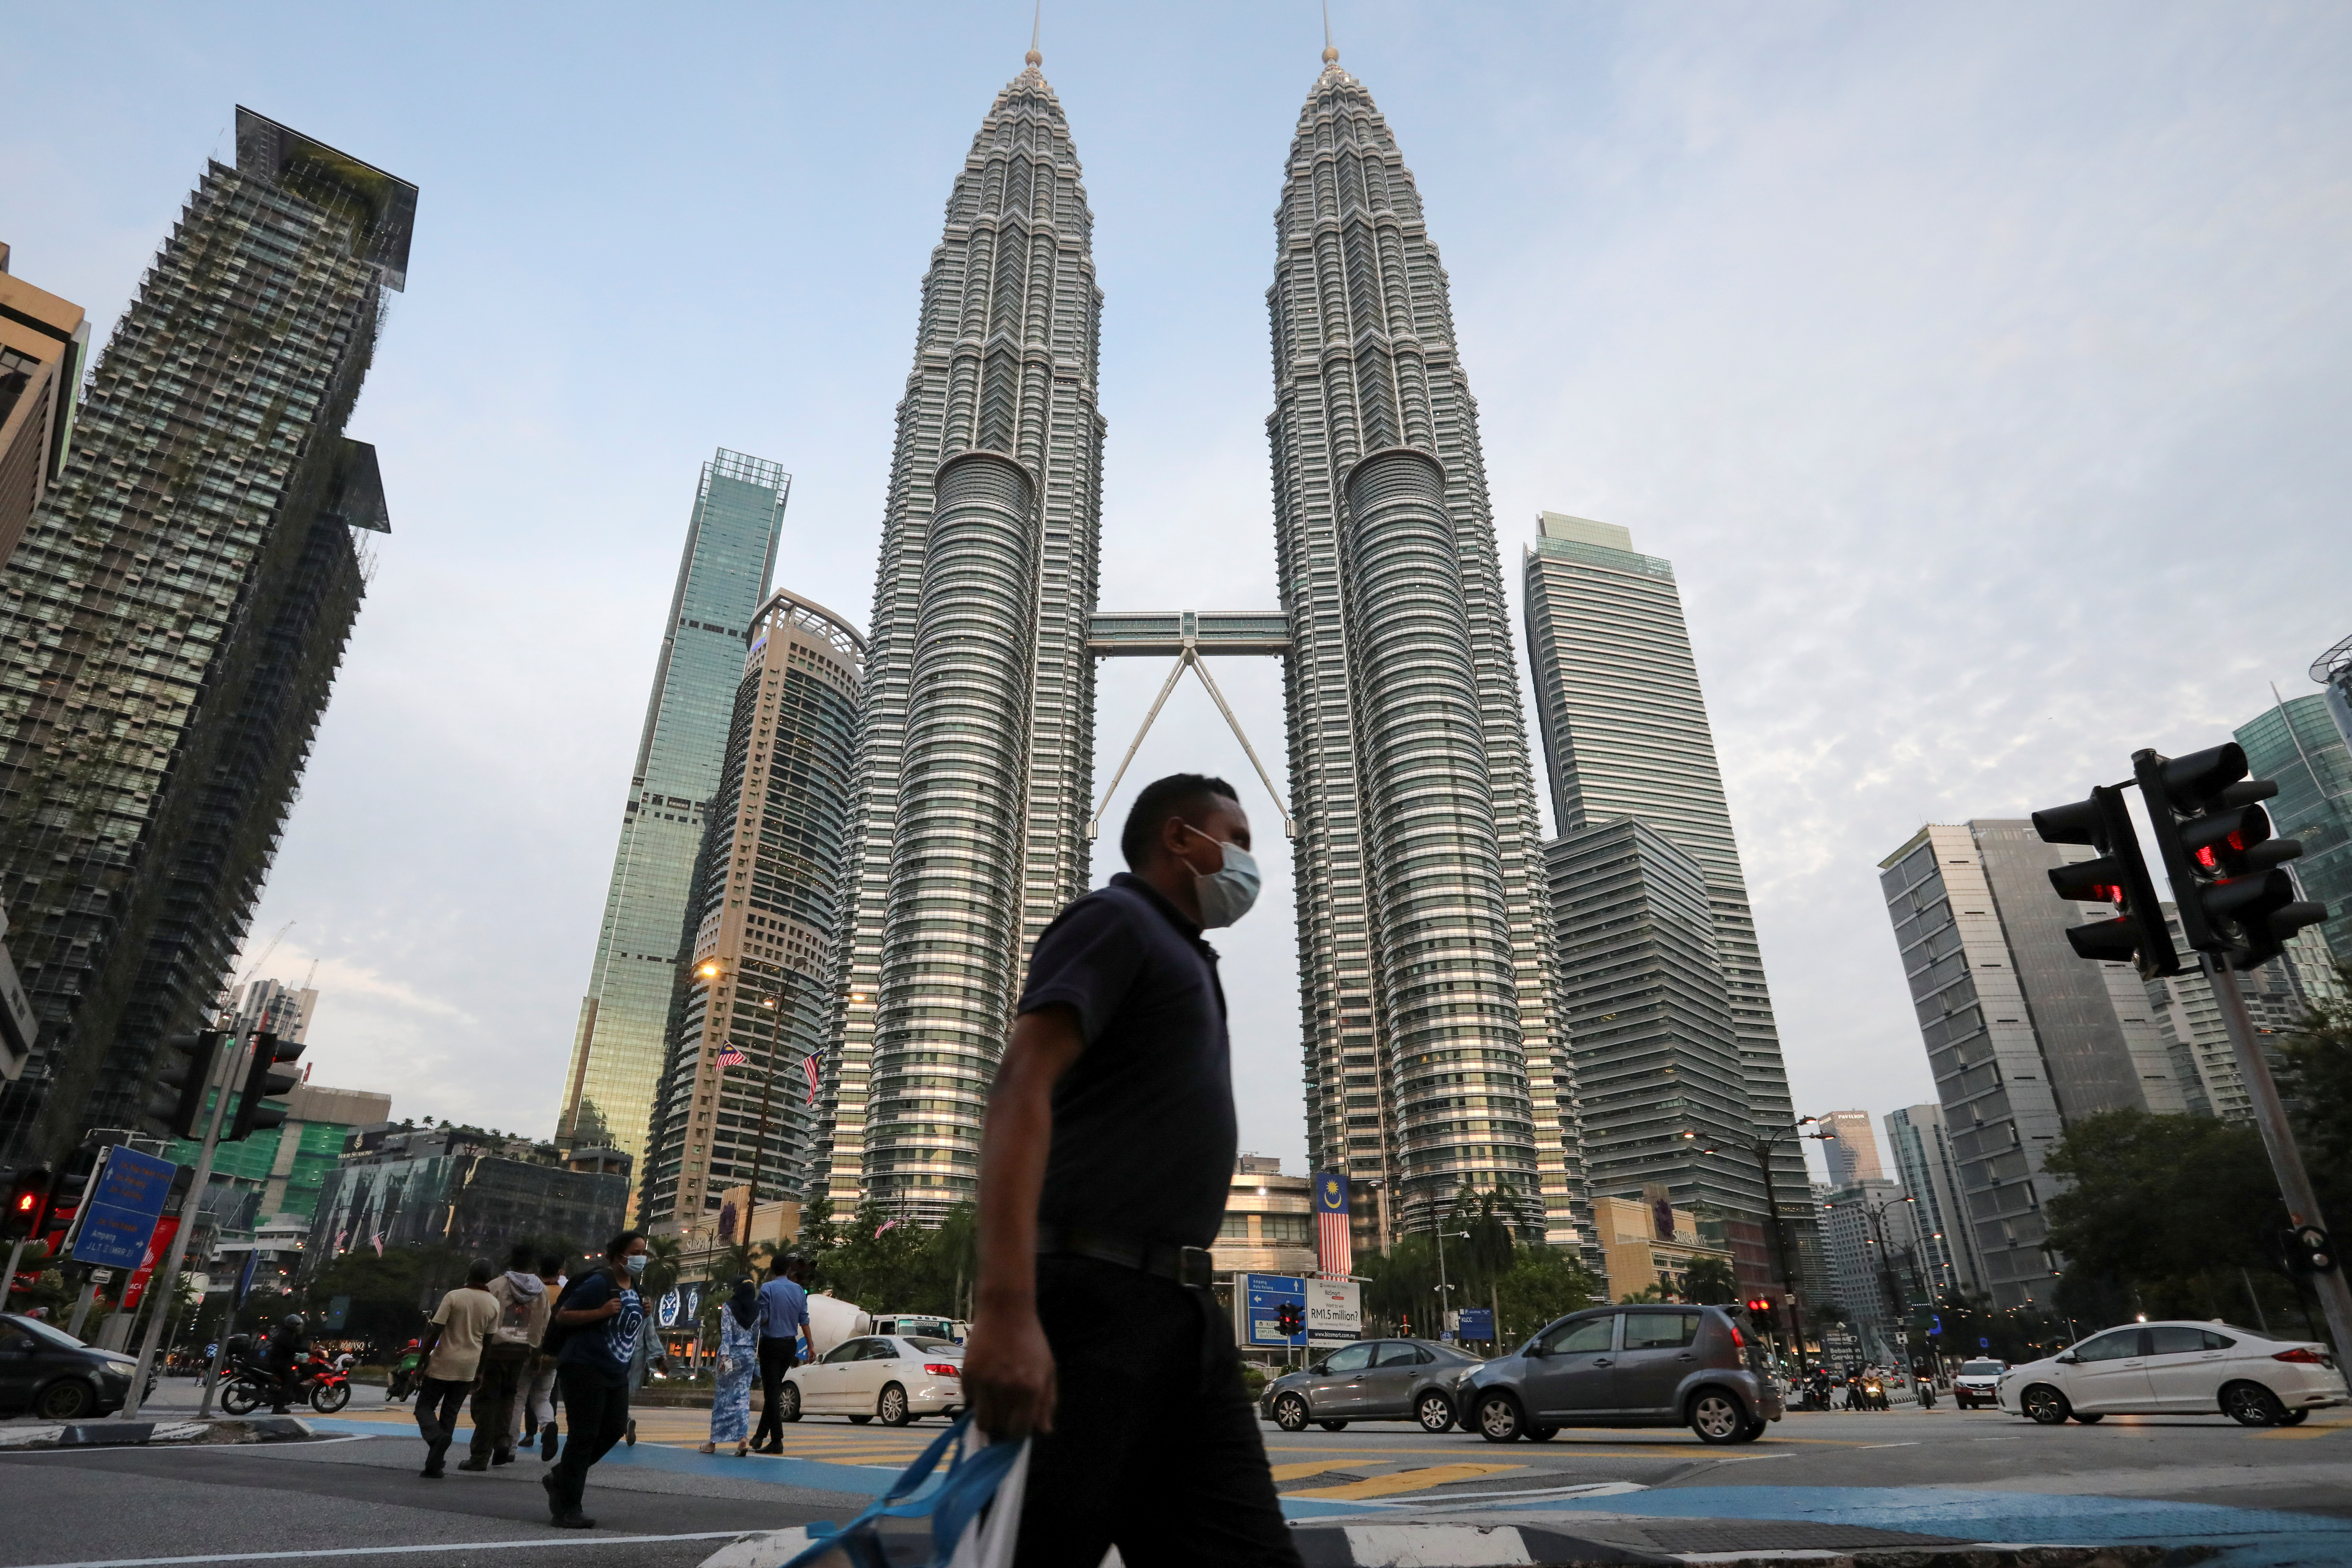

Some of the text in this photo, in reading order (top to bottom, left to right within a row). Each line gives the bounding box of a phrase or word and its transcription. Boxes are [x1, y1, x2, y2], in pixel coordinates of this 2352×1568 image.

[92, 1230, 116, 1243] Ampang
[1672, 1230, 1692, 1245] SURIA
[686, 1239, 705, 1251] SURIA
[126, 1249, 134, 1257] 2)
[1312, 1309, 1358, 1321] RM1.5 million?
